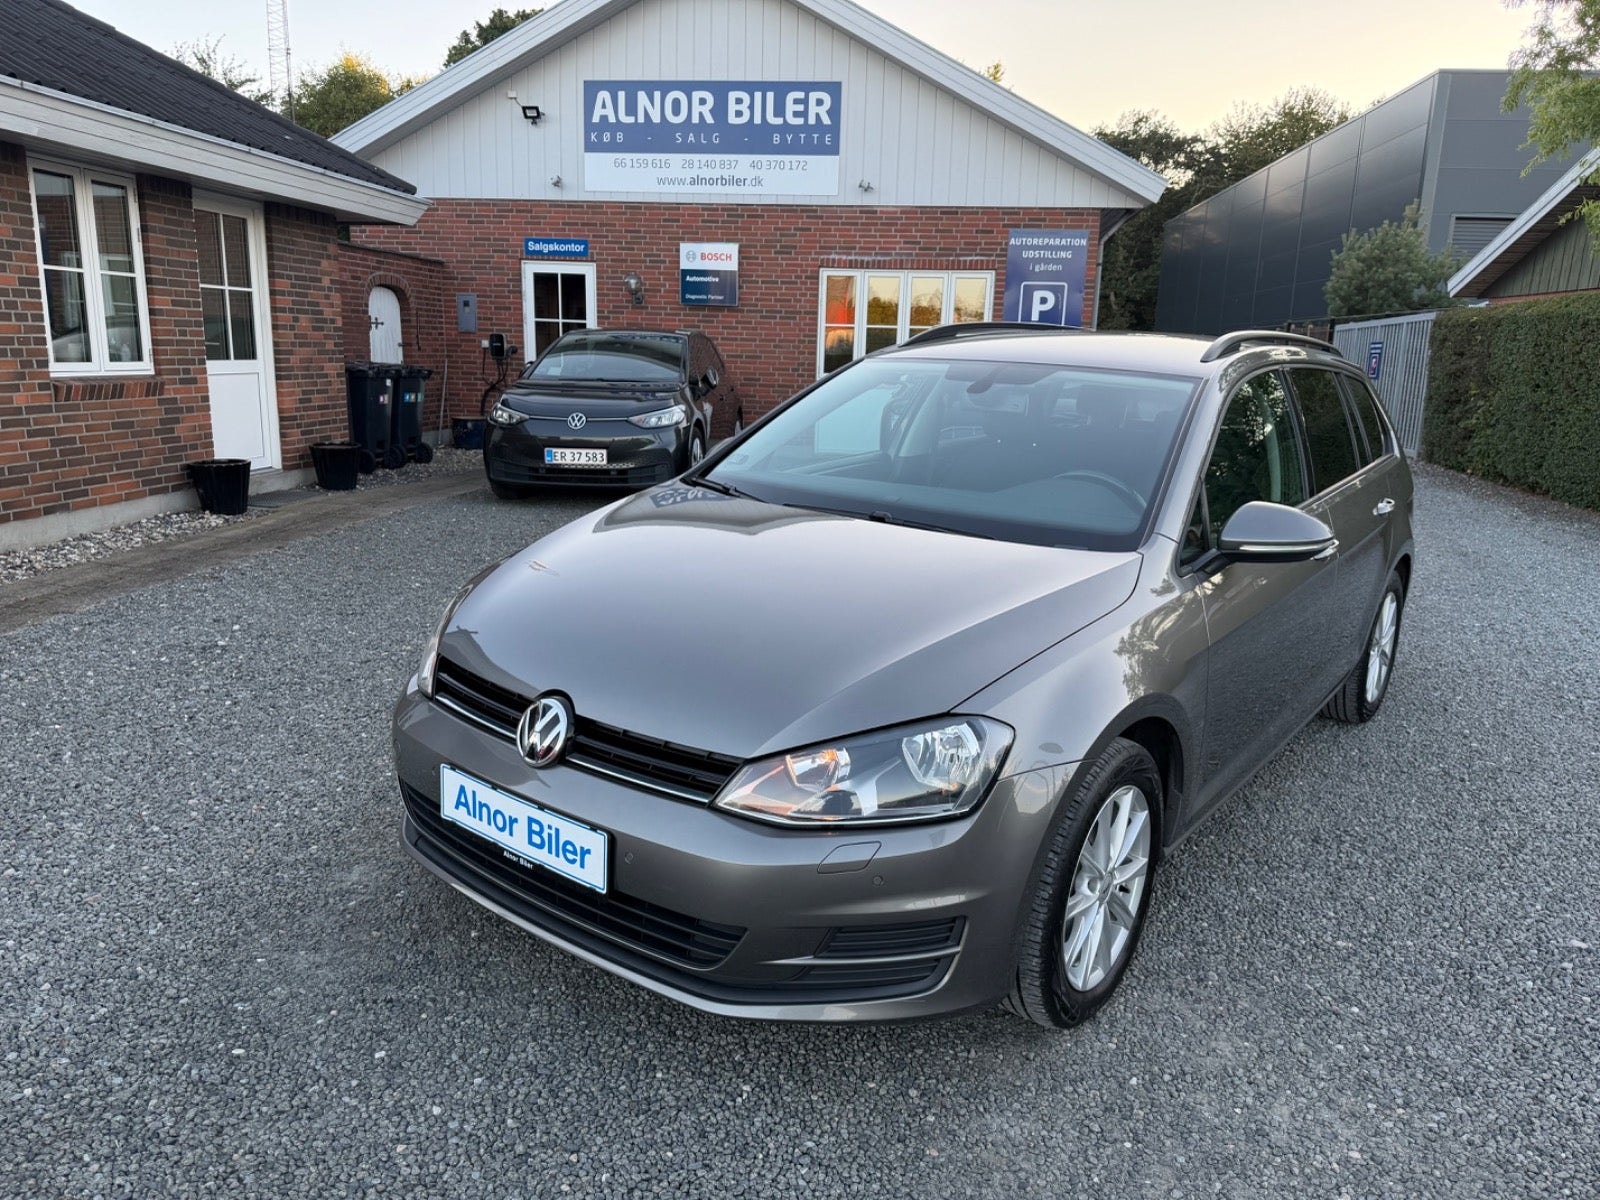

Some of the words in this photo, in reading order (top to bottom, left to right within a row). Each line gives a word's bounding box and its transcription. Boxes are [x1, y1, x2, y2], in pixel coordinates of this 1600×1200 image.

[591, 90, 715, 124] ALNOR
[727, 91, 832, 125] BILER
[590, 132, 624, 143] KØB
[675, 133, 720, 144] SALG
[773, 134, 832, 145] BYTTE
[613, 158, 627, 168] 66
[629, 158, 649, 169] 159
[651, 159, 671, 169] 616
[681, 159, 695, 169] 28
[697, 159, 716, 169] 140
[719, 159, 739, 170] 837
[749, 160, 763, 170] 40
[765, 160, 785, 170] 370
[788, 160, 808, 171] 172
[656, 174, 763, 187] www.alnorbiler.dk
[527, 241, 585, 253] Salgskontor
[1009, 237, 1087, 246] AUTOREPARATION
[700, 252, 732, 261] BOSCH
[1022, 250, 1072, 259] UDSTILLING
[1034, 262, 1063, 272] gården
[1031, 290, 1055, 321] P
[553, 451, 567, 462] ER
[569, 451, 582, 462] 37
[585, 451, 605, 463] 583
[454, 783, 518, 837] Alnor
[526, 815, 591, 869] Biler
[503, 850, 519, 862] Alnor
[519, 856, 534, 870] Biler
